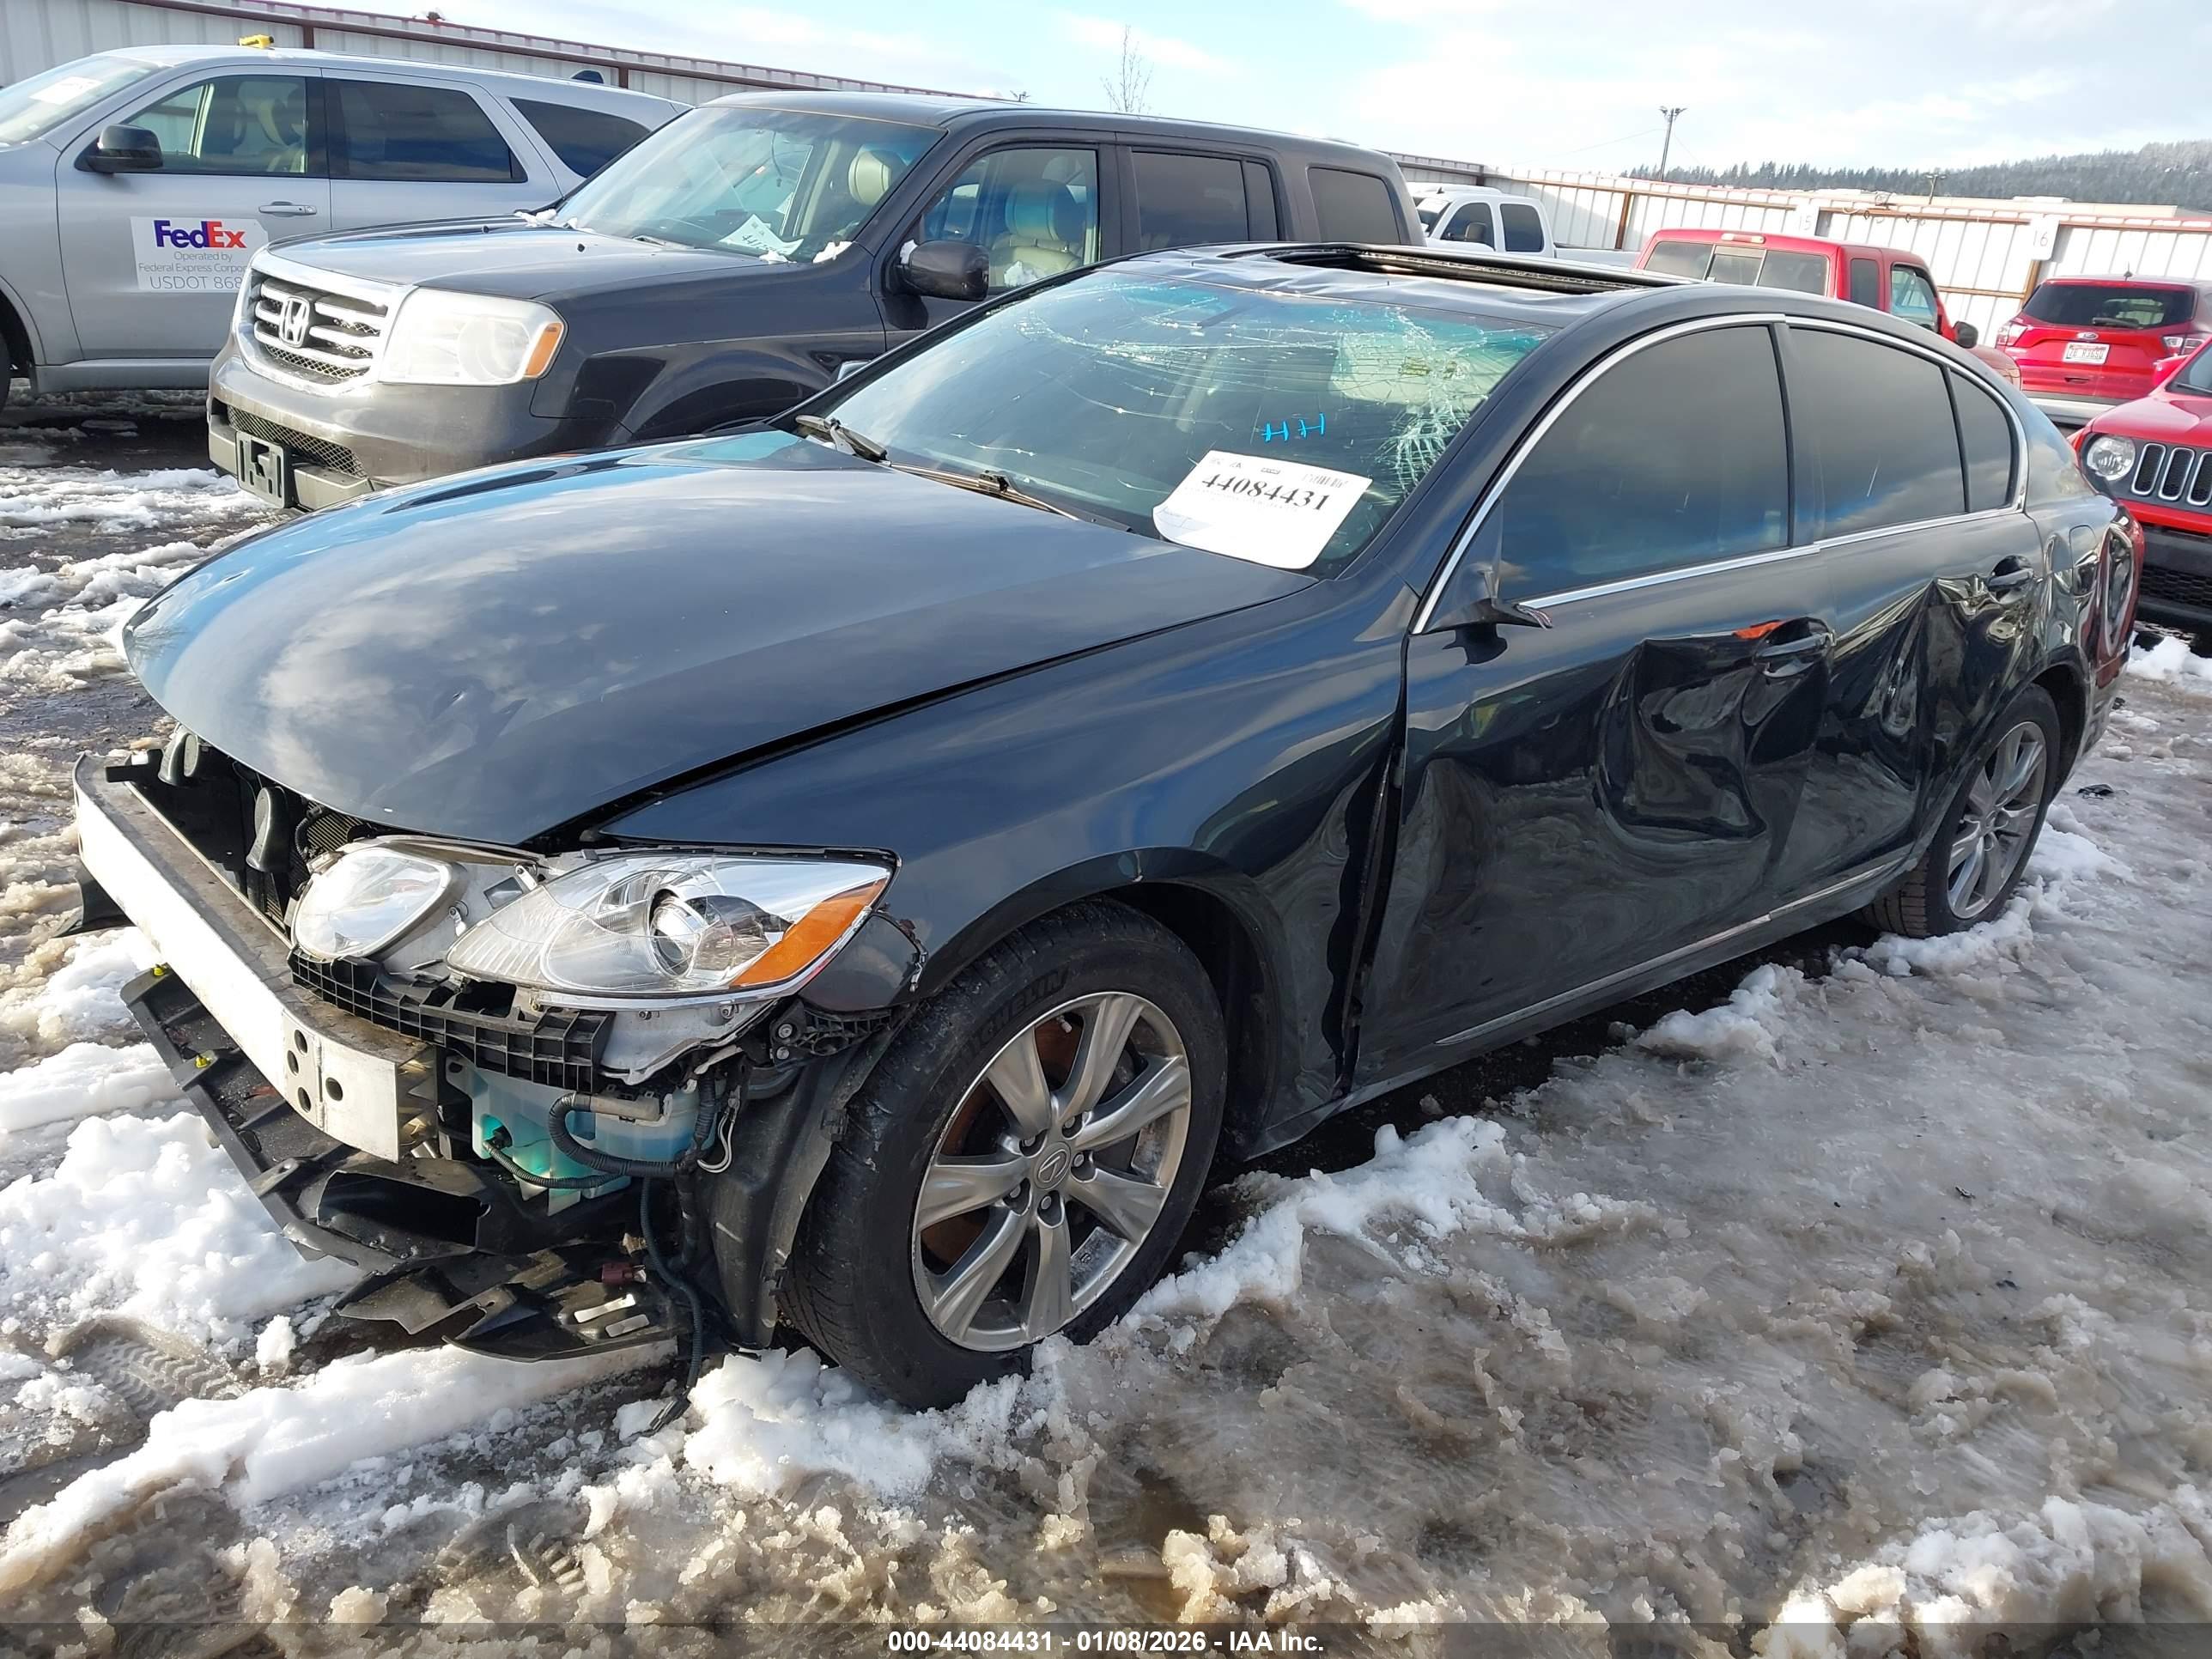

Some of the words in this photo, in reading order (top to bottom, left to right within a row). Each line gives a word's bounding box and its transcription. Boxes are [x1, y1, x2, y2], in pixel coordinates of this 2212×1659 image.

[154, 220, 247, 248] FedEx
[2033, 230, 2048, 246] 16
[174, 251, 219, 261] Operated
[222, 252, 233, 262] by
[138, 263, 173, 272] Federal
[176, 264, 212, 274] Express
[150, 276, 208, 289] USDOT
[1201, 473, 1330, 511] 44084431
